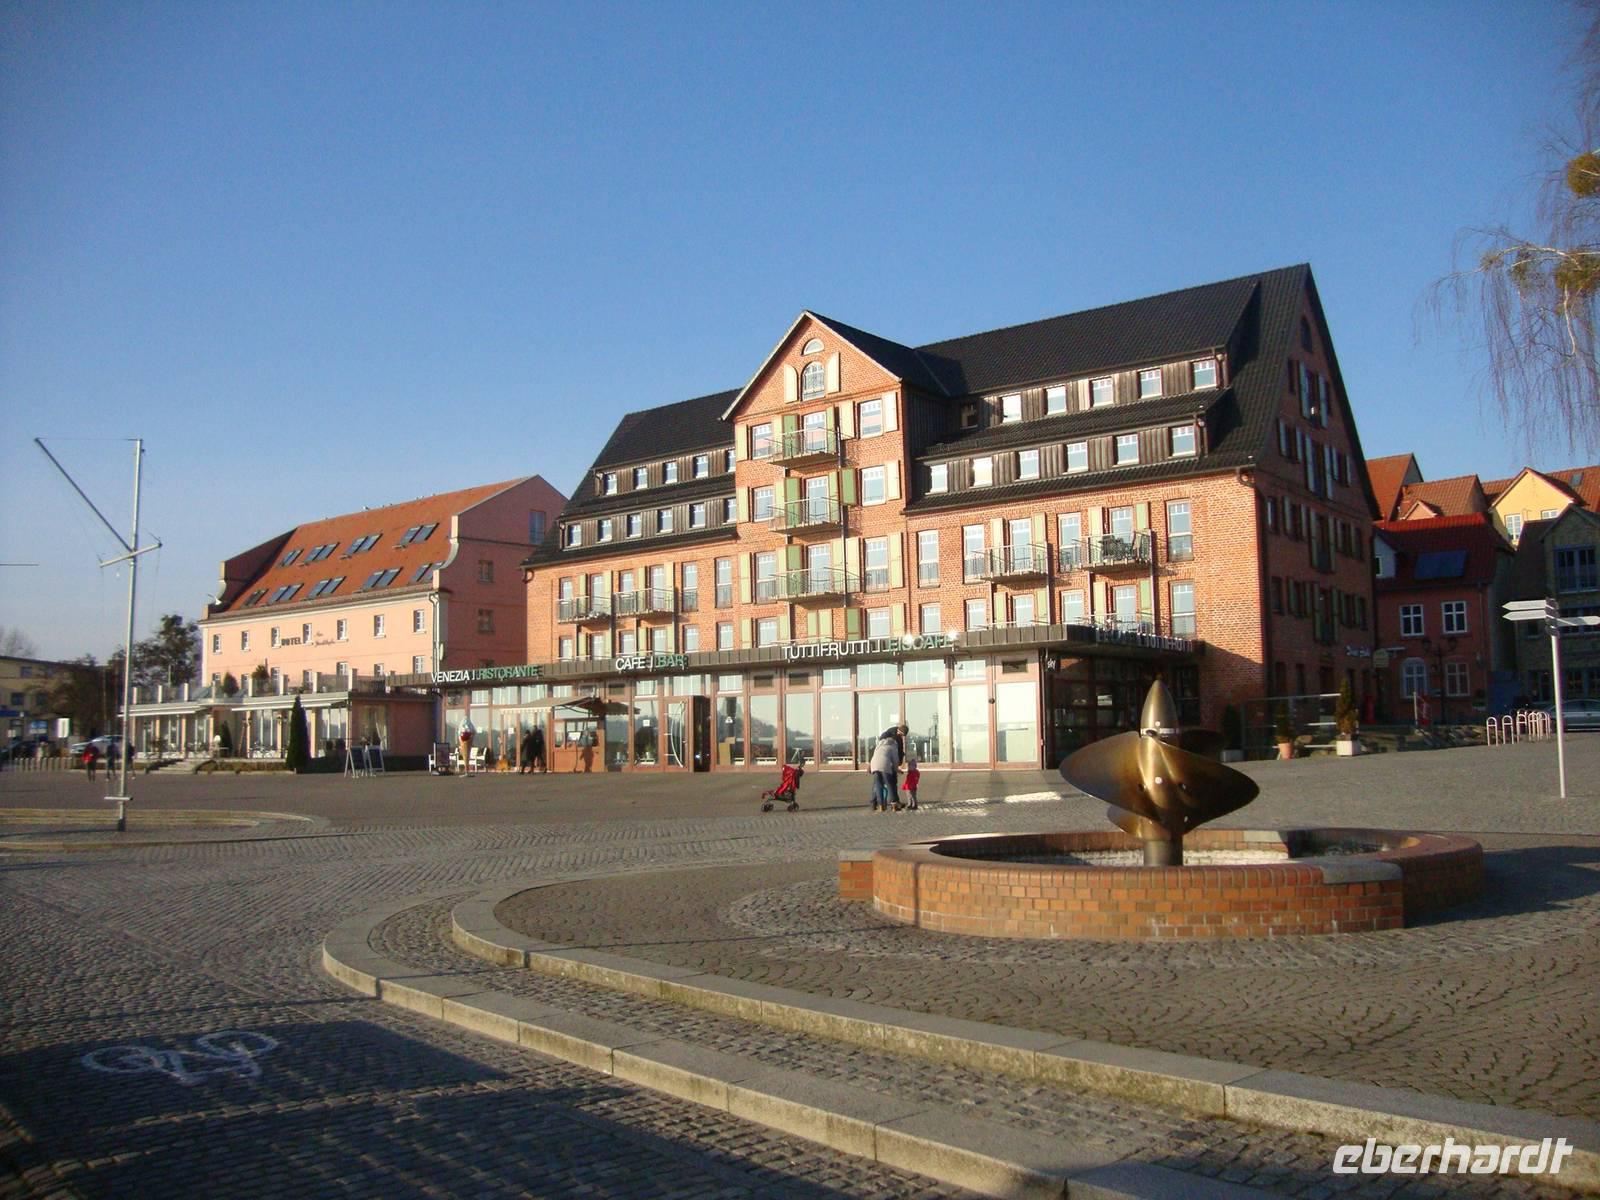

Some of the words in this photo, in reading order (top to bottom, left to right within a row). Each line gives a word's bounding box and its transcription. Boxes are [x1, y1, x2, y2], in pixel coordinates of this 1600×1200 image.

[781, 639, 870, 659] TUTTIFRUTTI
[888, 633, 954, 653] EISCAFE
[615, 656, 646, 671] CAFE
[658, 654, 685, 669] BAR
[431, 670, 470, 683] VENEZIA
[479, 665, 538, 680] RISTORANTE
